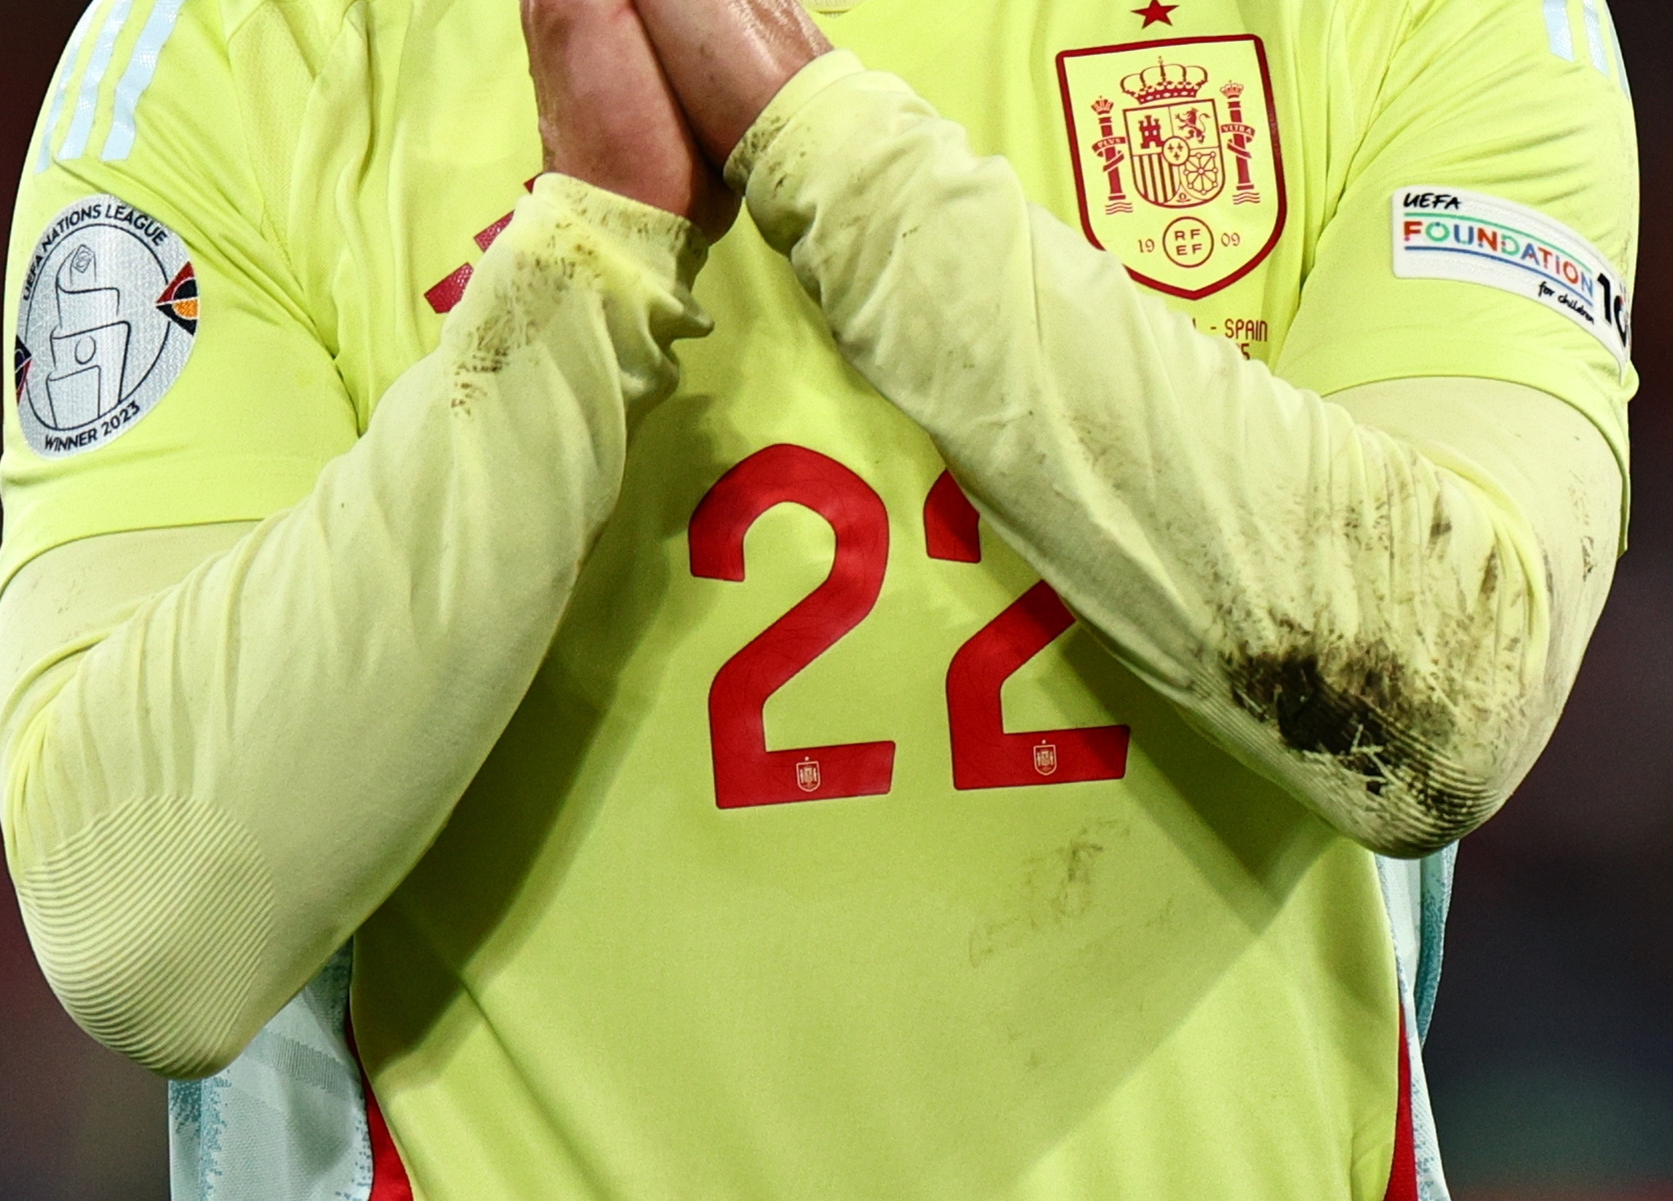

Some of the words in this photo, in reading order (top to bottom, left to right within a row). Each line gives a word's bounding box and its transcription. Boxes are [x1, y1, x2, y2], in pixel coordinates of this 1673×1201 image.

[1403, 192, 1462, 210] UEFA
[23, 254, 44, 301] UEFA
[41, 204, 102, 253] NATIONS
[104, 204, 168, 247] LEAGUE
[1138, 238, 1155, 253] 19
[1220, 232, 1241, 247] 09
[1403, 221, 1594, 298] FOUNDATION
[1538, 280, 1556, 297] for
[1557, 294, 1595, 325] children
[1224, 318, 1268, 343] SPAIN
[44, 428, 98, 452] WINNER
[103, 400, 141, 437] 2023
[687, 442, 1131, 810] 22
